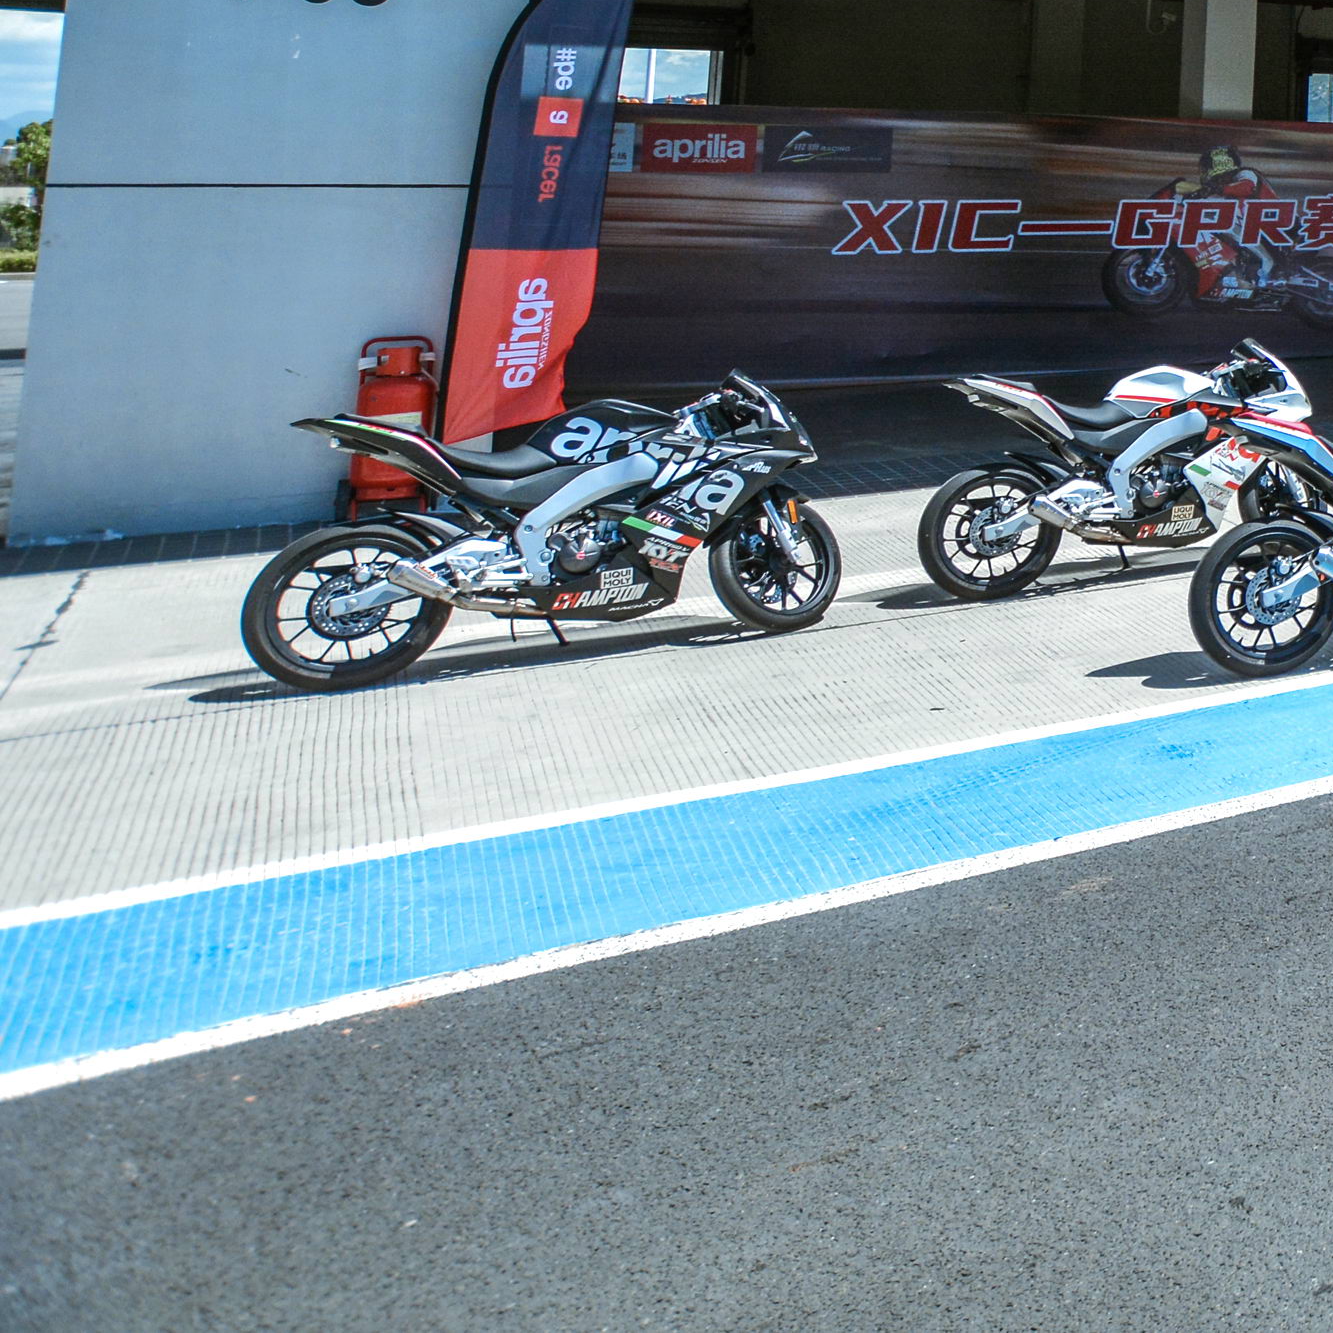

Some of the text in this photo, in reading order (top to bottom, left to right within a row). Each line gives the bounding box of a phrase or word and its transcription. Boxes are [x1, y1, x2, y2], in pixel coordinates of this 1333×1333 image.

[653, 133, 745, 162] aprilia
[1173, 506, 1193, 514] LIQUI
[1173, 512, 1193, 520] MOLY
[1136, 517, 1203, 538] CHAMPION
[603, 571, 632, 580] LIQUI
[603, 578, 632, 588] MOLY
[552, 582, 649, 610] CHAMPION
